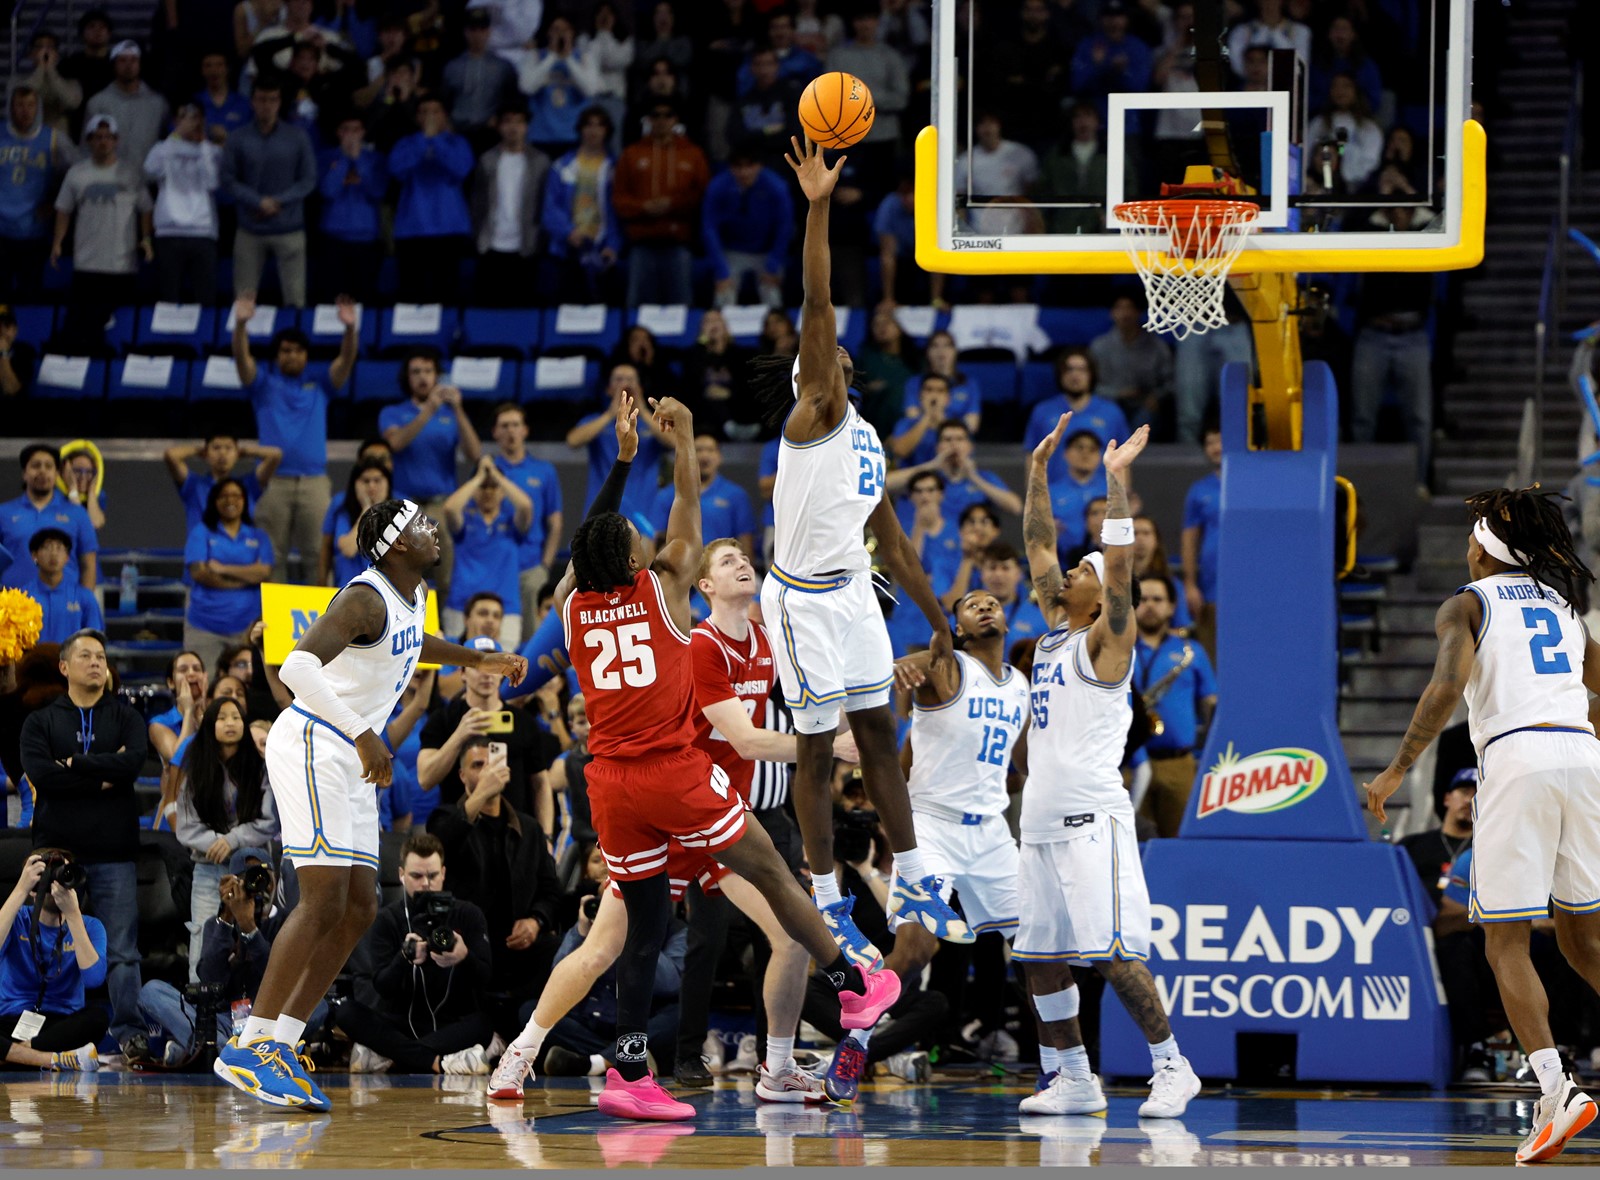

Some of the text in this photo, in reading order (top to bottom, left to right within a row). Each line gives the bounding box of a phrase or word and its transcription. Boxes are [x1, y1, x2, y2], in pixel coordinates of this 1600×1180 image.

[952, 238, 1003, 250] SPALDING
[851, 428, 886, 457] UCL
[858, 455, 885, 496] 24
[291, 609, 318, 640] N
[580, 602, 648, 624] BLACKWELL
[391, 624, 424, 656] UCL
[583, 621, 657, 690] 25
[1521, 607, 1572, 674] 2
[395, 656, 413, 693] 3
[1032, 662, 1065, 687] CLA
[968, 696, 1022, 730] UCLA
[1030, 690, 1050, 731] 55
[976, 724, 1009, 767] 12
[1200, 758, 1315, 815] LIBMAN
[1148, 903, 1392, 965] READY
[1154, 974, 1354, 1019] WESCOM
